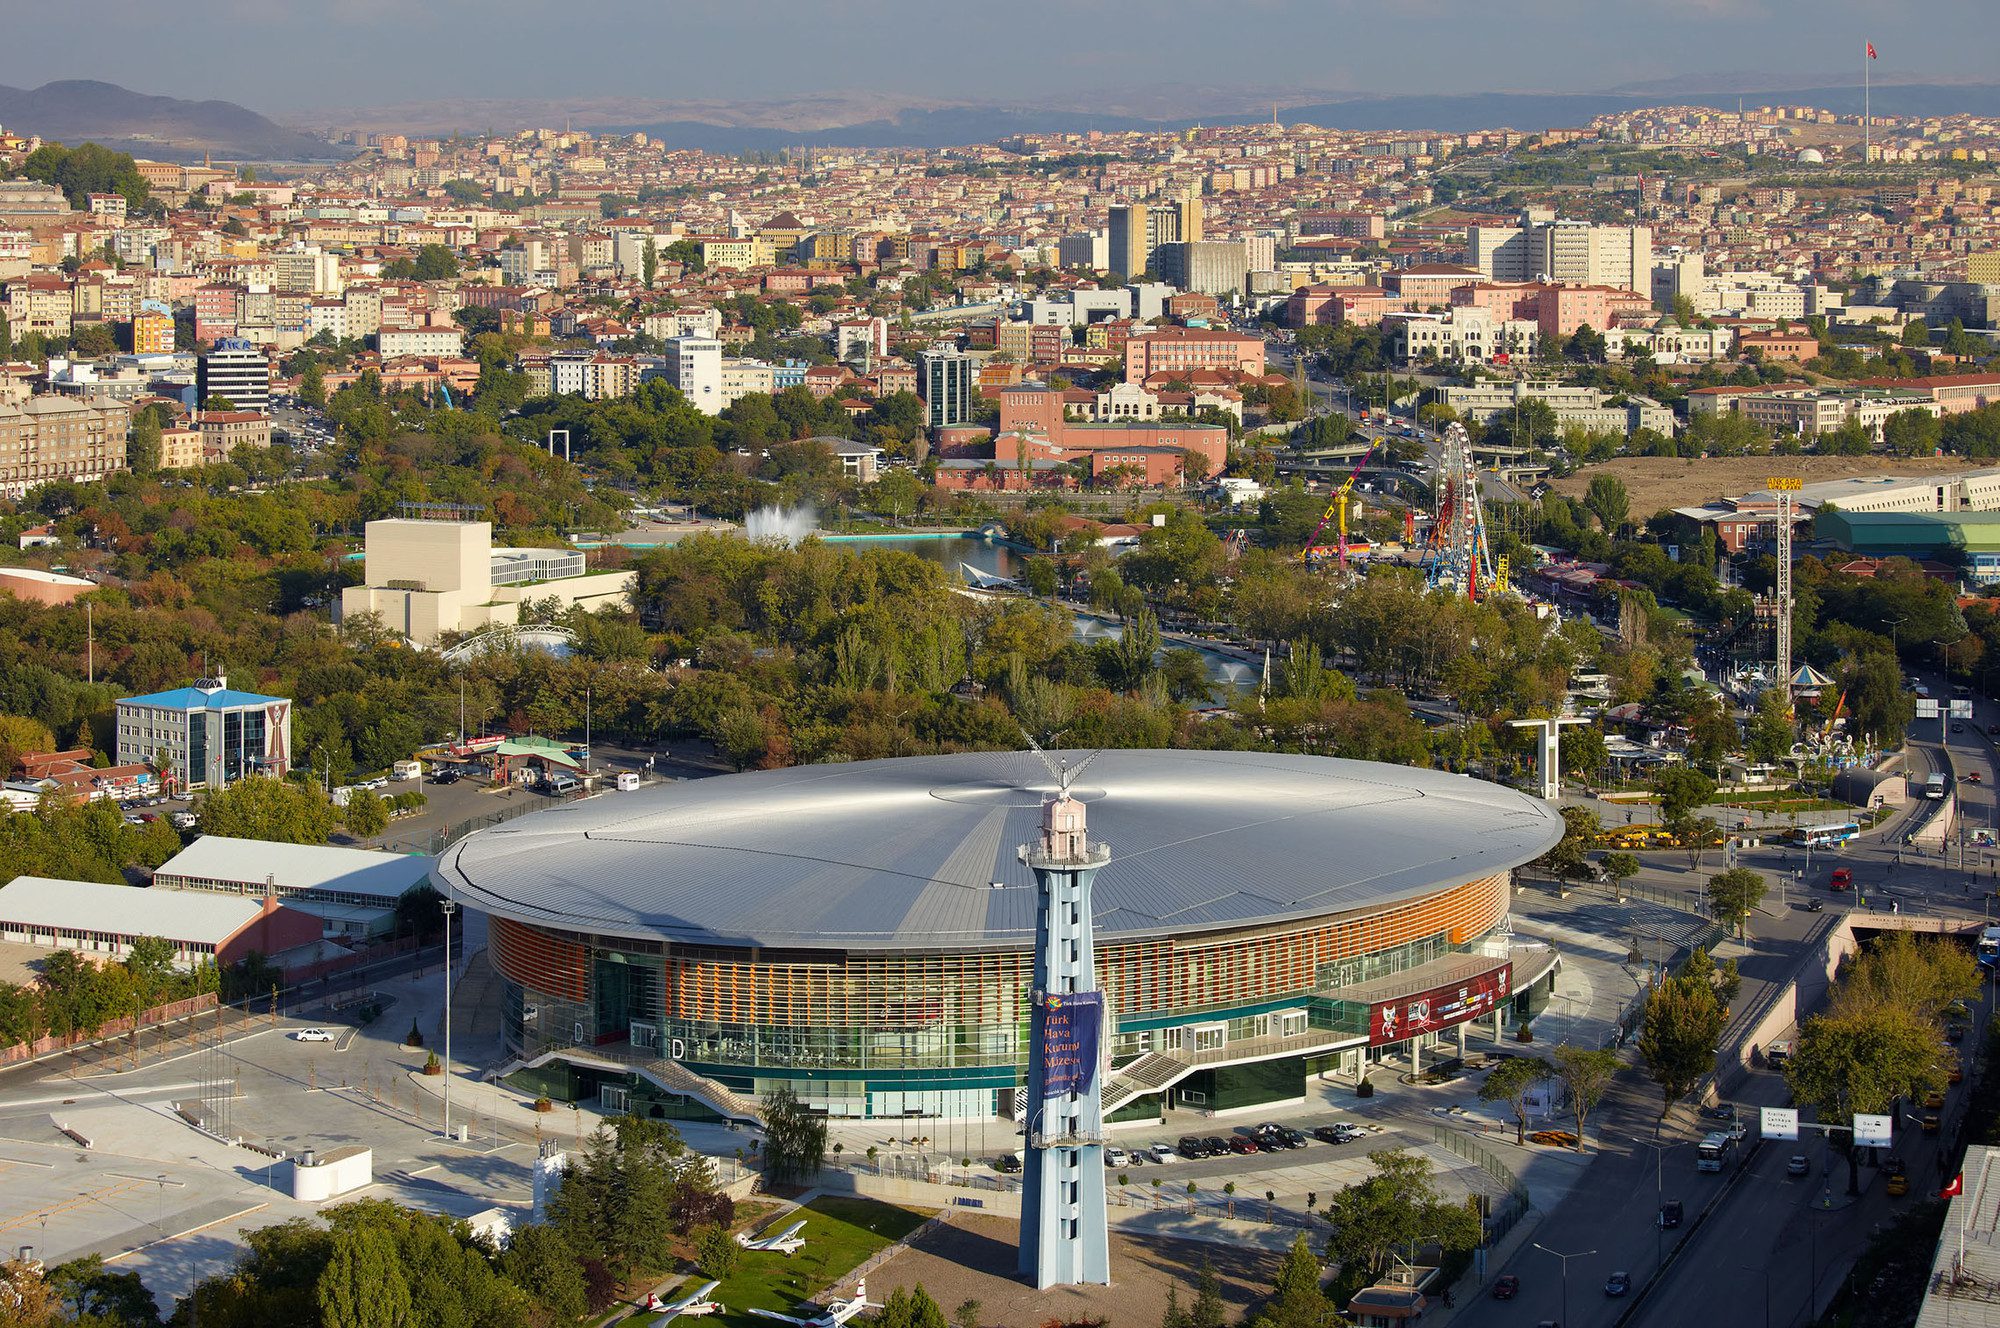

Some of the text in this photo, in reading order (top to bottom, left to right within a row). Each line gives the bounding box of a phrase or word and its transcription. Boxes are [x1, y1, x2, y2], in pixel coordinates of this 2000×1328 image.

[1045, 1015, 1070, 1026] Türk
[1273, 1014, 1278, 1026] E
[575, 1022, 584, 1043] D
[1044, 1028, 1071, 1040] Hava
[1186, 1028, 1191, 1039] E
[1139, 1031, 1150, 1053] E
[672, 1038, 685, 1059] D
